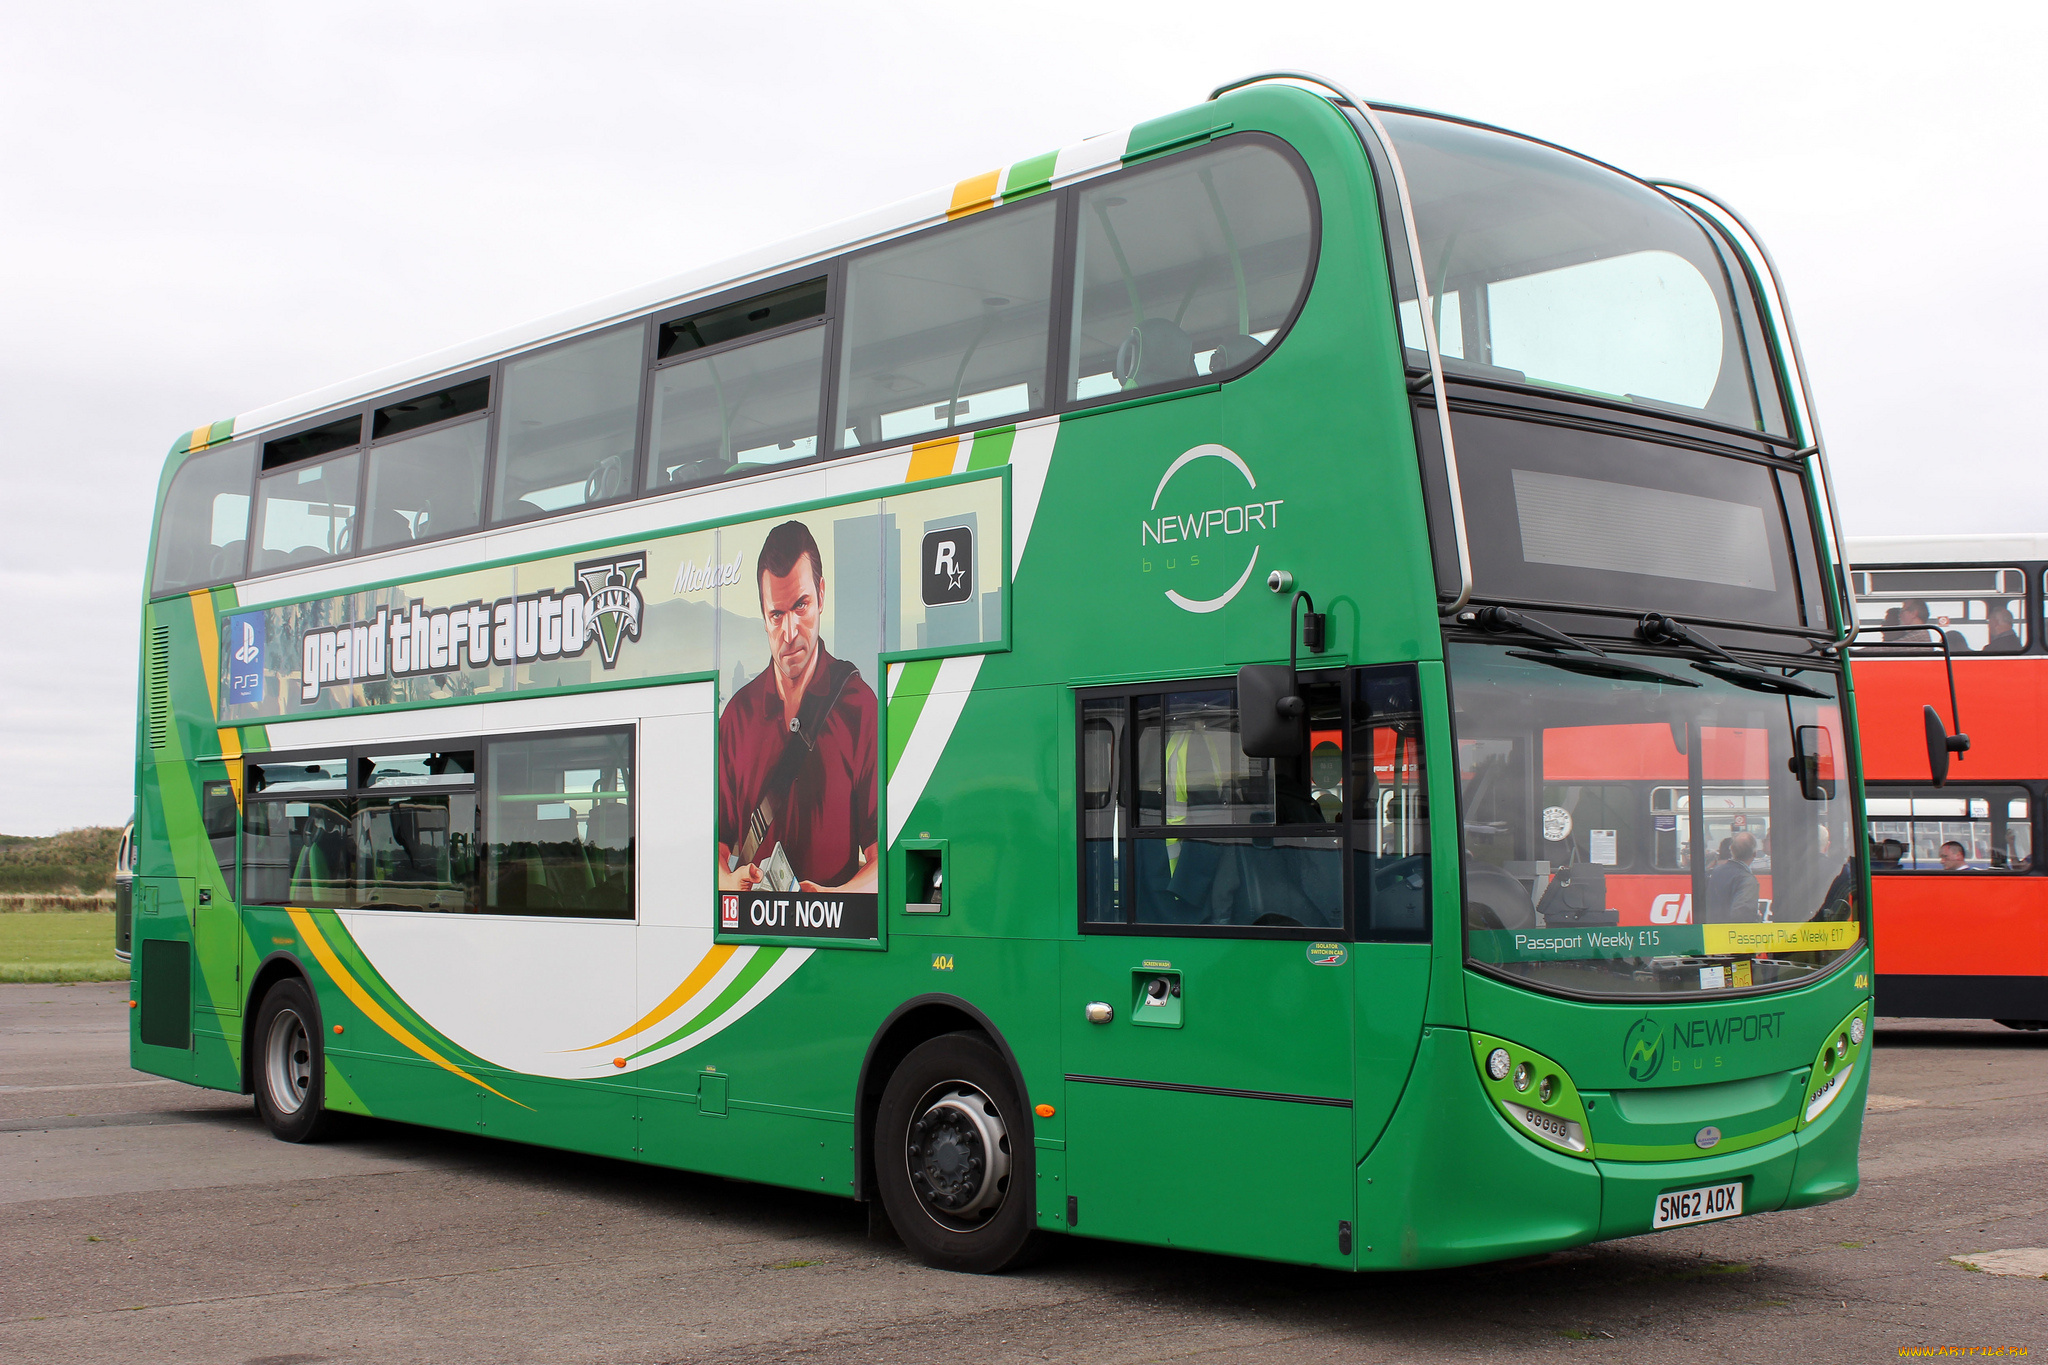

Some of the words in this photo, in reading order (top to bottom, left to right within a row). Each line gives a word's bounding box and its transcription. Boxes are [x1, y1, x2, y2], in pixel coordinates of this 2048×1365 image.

[1142, 499, 1284, 546] NEWPORT
[672, 550, 744, 595] Michael
[1142, 554, 1200, 573] bus
[595, 590, 630, 610] FIVE
[301, 609, 387, 701] grand
[389, 603, 490, 674] theft
[494, 592, 585, 661] auto
[234, 673, 259, 690] PS3
[723, 897, 738, 919] 18
[750, 899, 789, 927] OUT
[795, 900, 844, 929] NOW
[1515, 934, 1582, 953] Passport
[1587, 931, 1634, 950] Weekly
[1639, 930, 1660, 946] £15
[1728, 930, 1774, 947] Passport
[1777, 929, 1797, 943] Plus
[1800, 929, 1829, 945] Weekly
[1831, 928, 1844, 942] £17
[932, 955, 954, 970] 404
[1854, 974, 1869, 988] 404
[1673, 1011, 1785, 1049] NEWPORT
[1672, 1055, 1723, 1072] bus
[1660, 1191, 1701, 1222] SN62
[1705, 1186, 1736, 1214] AOX
